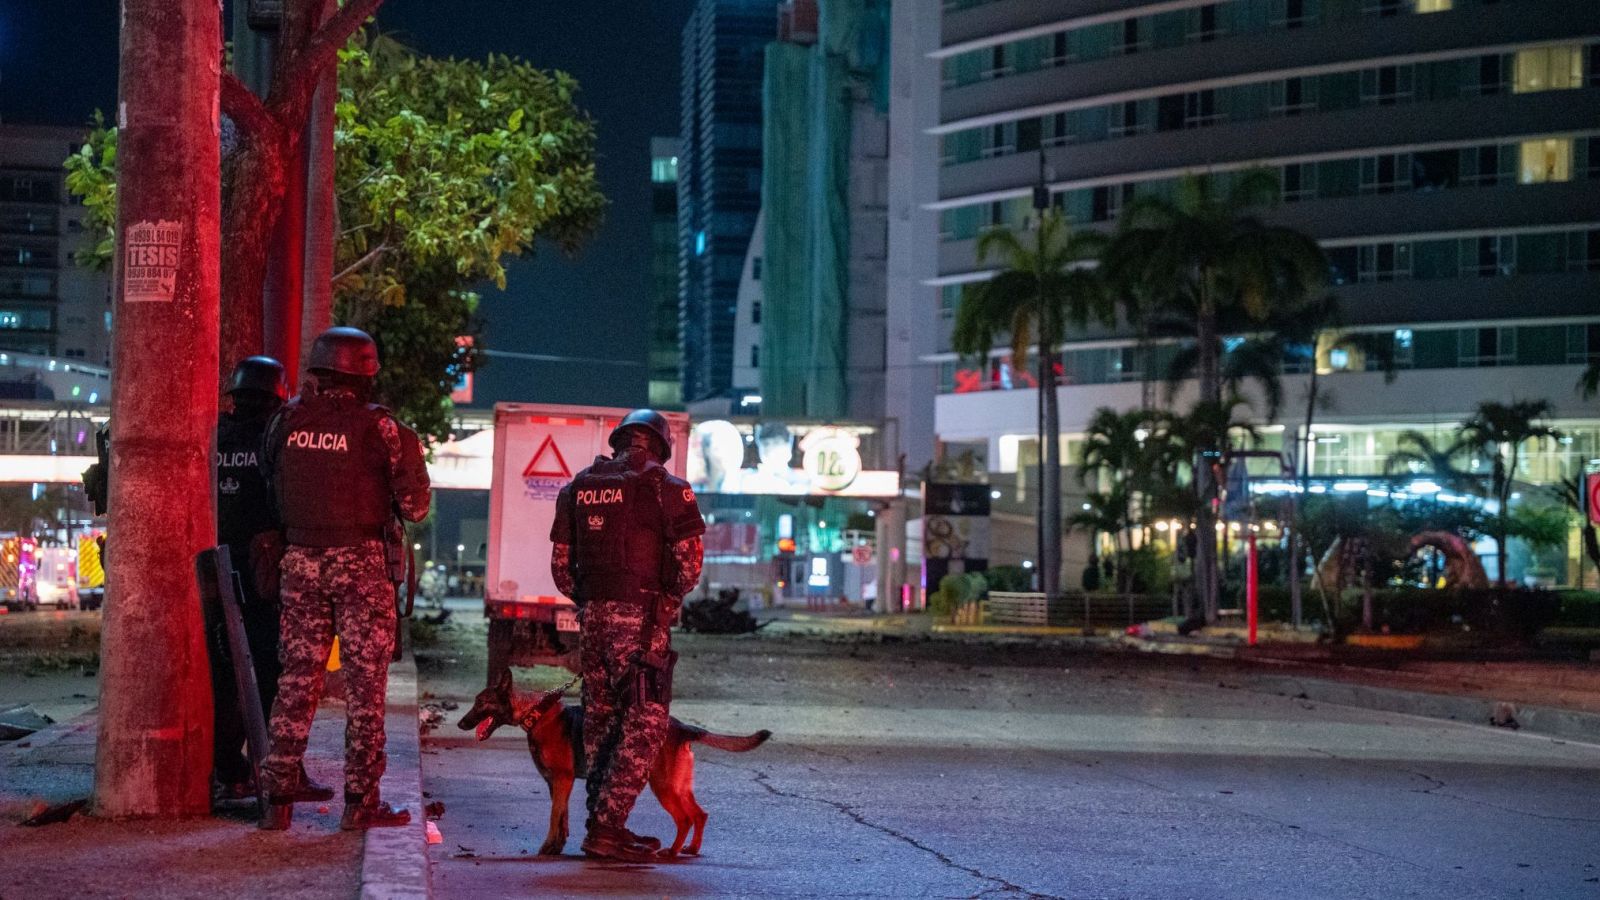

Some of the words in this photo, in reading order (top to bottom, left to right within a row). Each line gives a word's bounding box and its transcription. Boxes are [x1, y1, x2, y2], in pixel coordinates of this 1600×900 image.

[130, 246, 177, 266] TESIS
[287, 431, 348, 451] POLICIA
[216, 451, 258, 468] OLICIA
[576, 488, 623, 505] POLICIA
